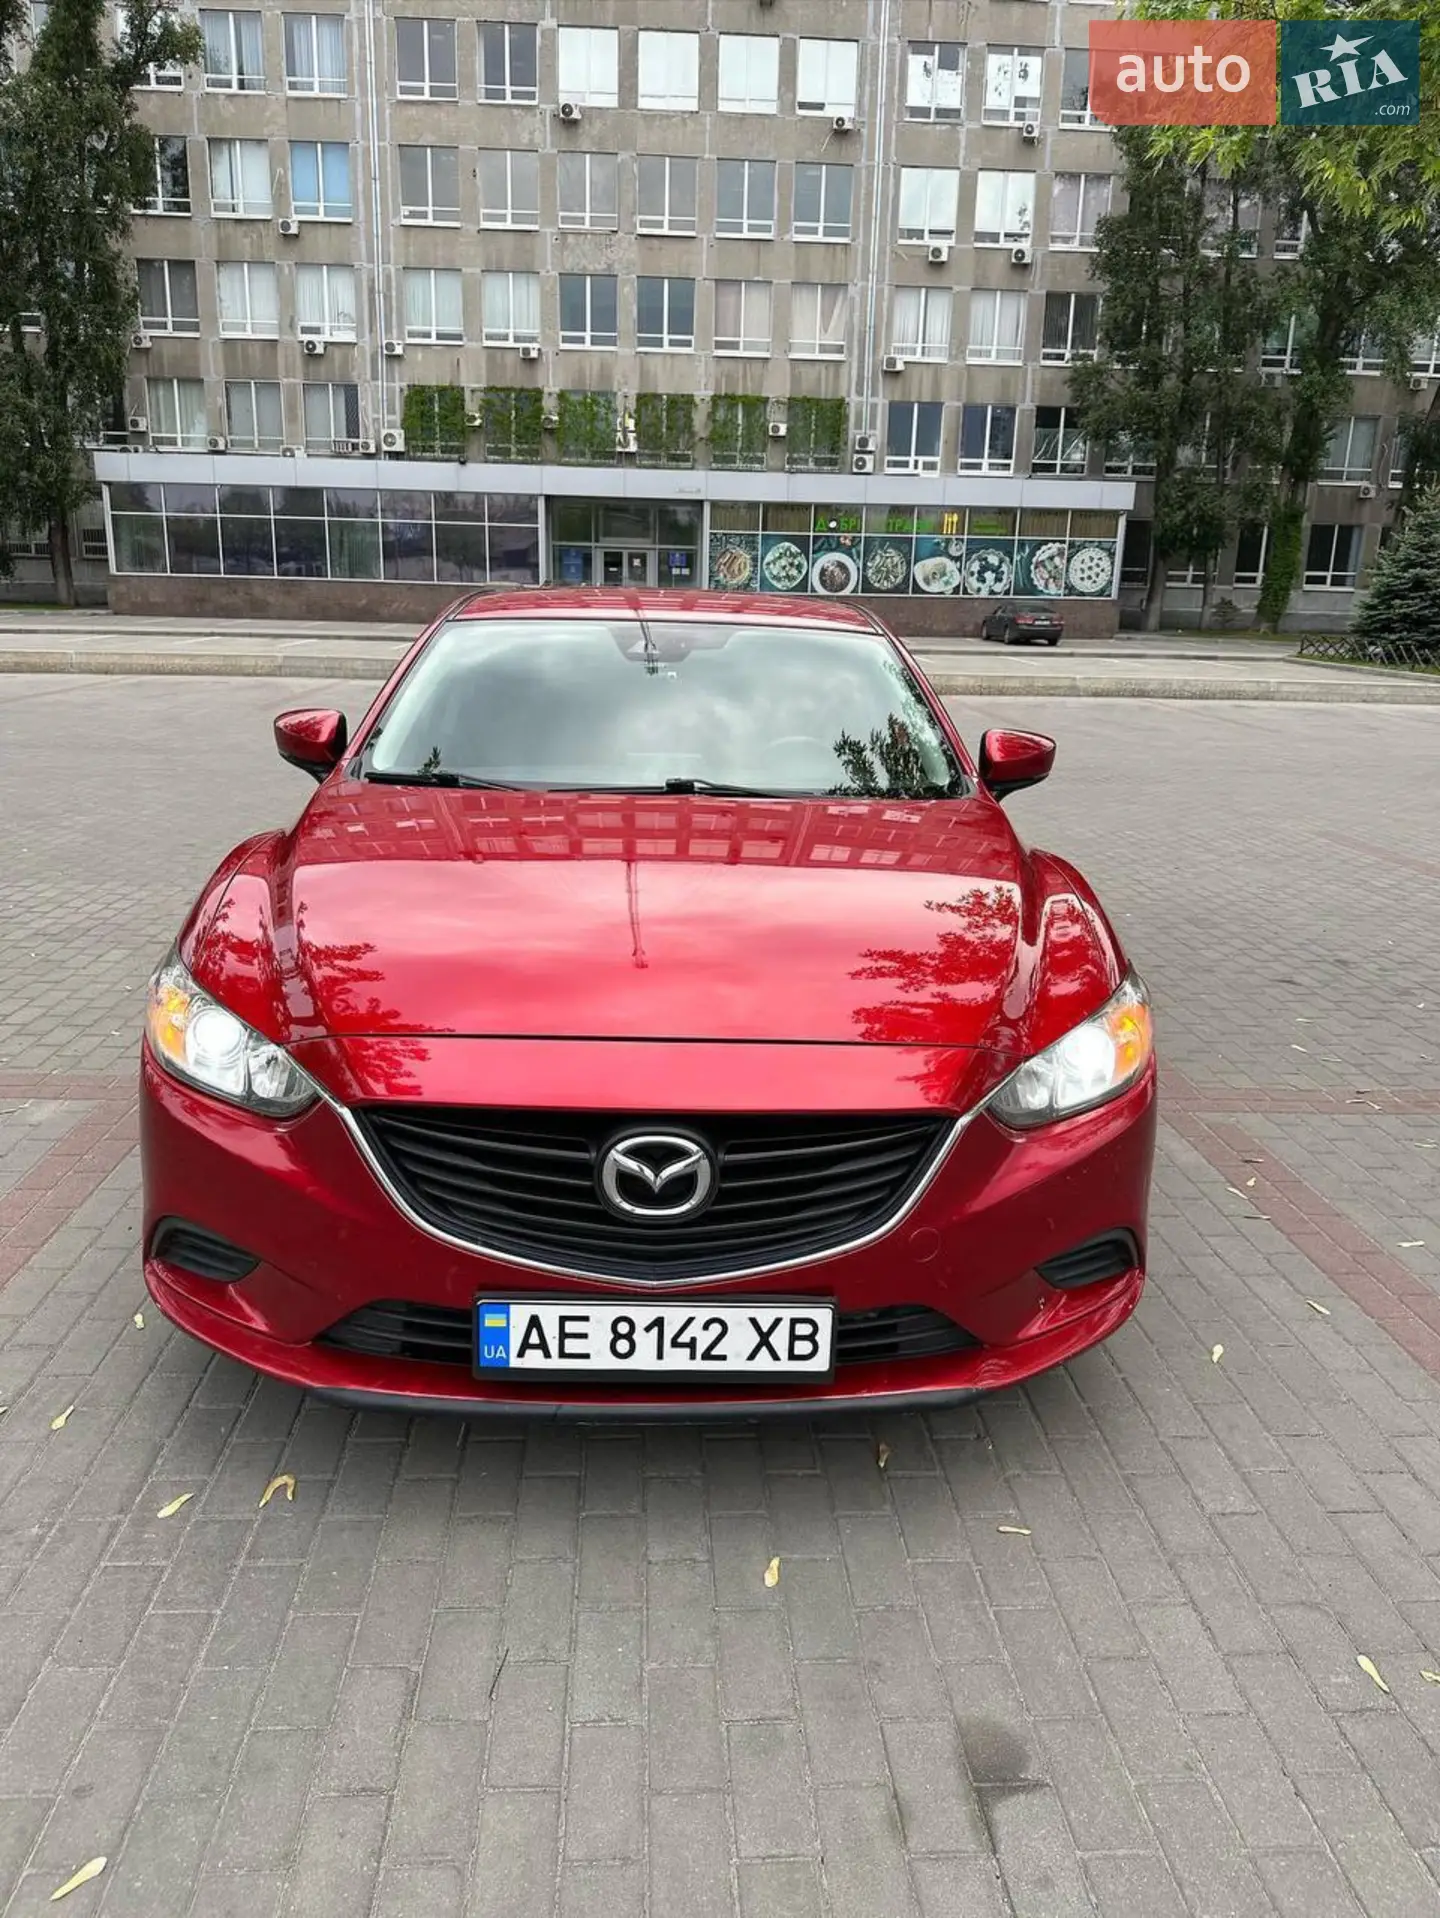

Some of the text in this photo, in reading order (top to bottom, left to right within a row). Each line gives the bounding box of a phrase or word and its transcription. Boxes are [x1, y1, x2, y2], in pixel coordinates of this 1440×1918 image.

[516, 1314, 820, 1361] AE 8142 XB
[484, 1347, 506, 1359] UA
